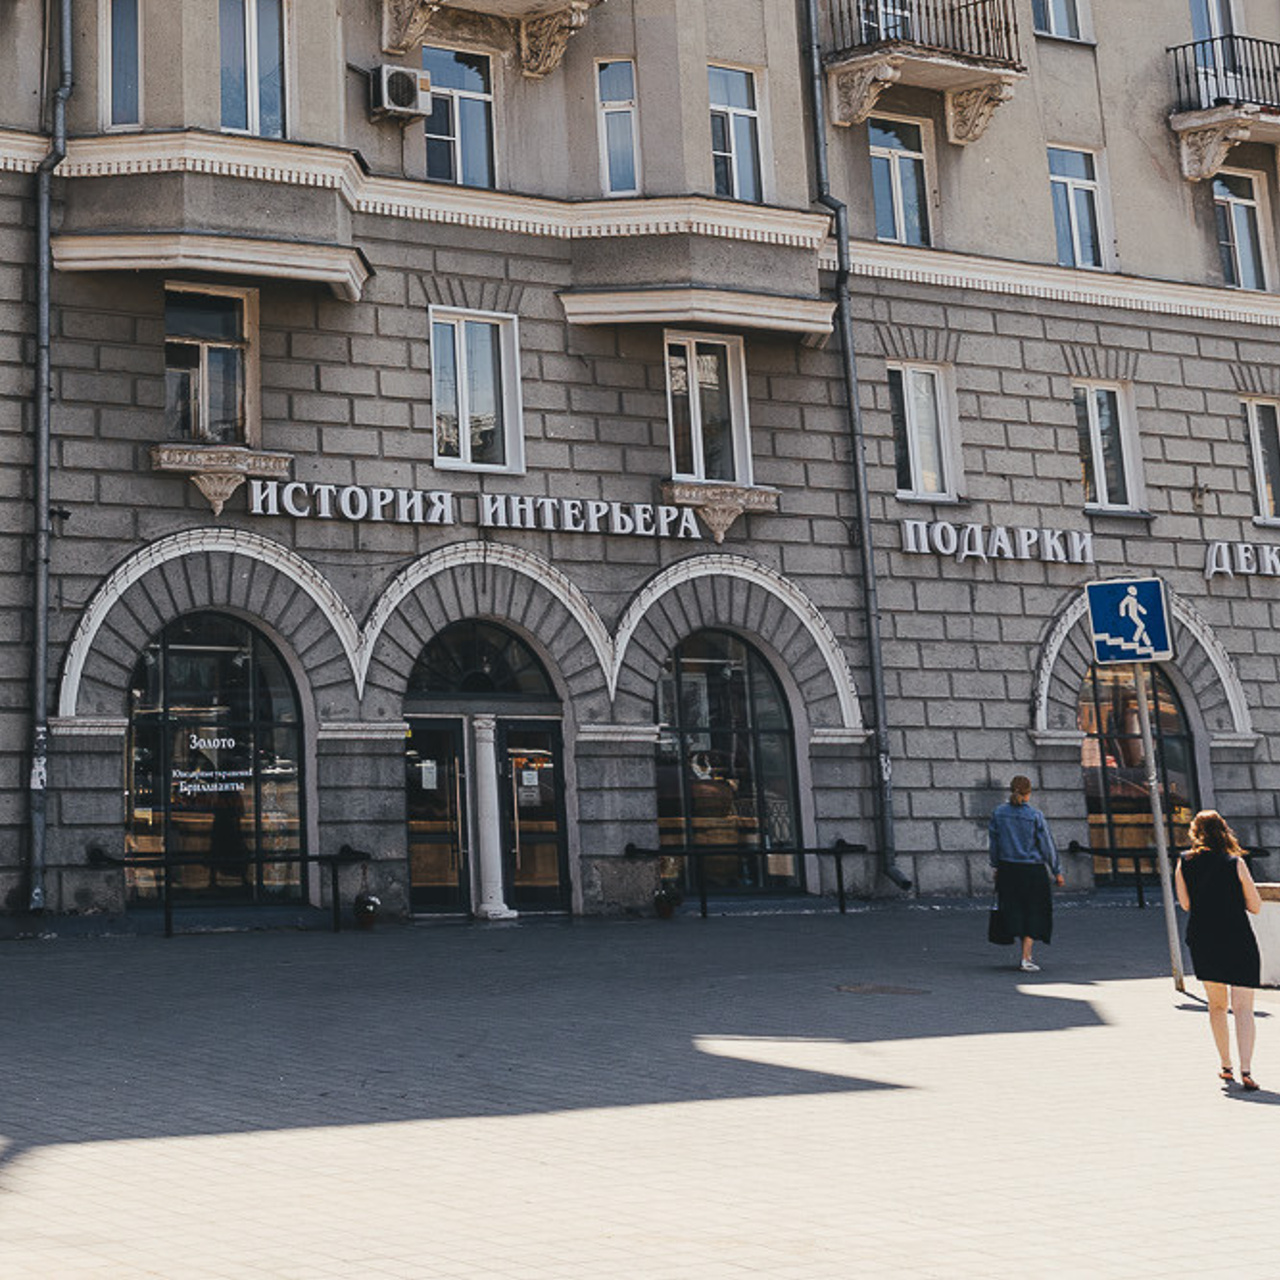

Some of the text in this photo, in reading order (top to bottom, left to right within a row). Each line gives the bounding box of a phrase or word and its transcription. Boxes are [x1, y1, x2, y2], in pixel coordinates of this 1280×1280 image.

[250, 480, 702, 539] ИСТОРИЯ ИНТЕРЬЕРА
[902, 519, 1095, 564] ПОДАРКИ
[189, 734, 236, 750] Золото
